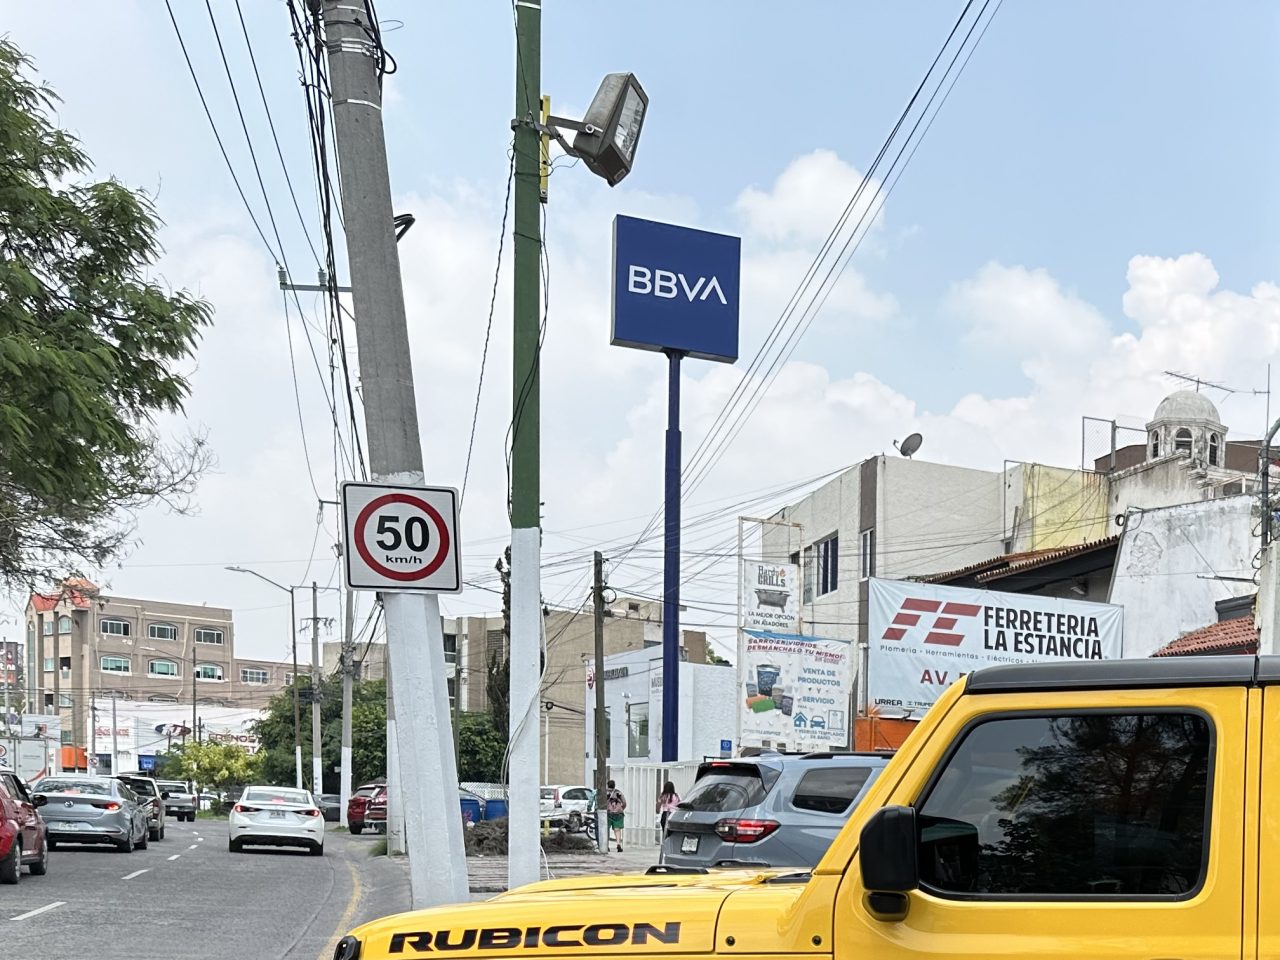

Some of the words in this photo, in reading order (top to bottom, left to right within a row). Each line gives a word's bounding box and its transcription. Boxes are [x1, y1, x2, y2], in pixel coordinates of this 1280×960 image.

[628, 265, 728, 304] BBVA
[376, 515, 430, 552] 50
[385, 555, 423, 564] km/h
[984, 605, 1100, 638] FERRETERIA
[984, 629, 1008, 652] LA
[1014, 632, 1103, 660] ESTANCIA
[926, 649, 979, 660] Herramientas
[803, 667, 825, 675] VENTA
[827, 669, 836, 677] DE
[920, 669, 953, 686] AV.
[798, 676, 841, 687] PRODUCTOS
[803, 696, 835, 705] SERVICIO
[388, 921, 681, 954] RUBICON
